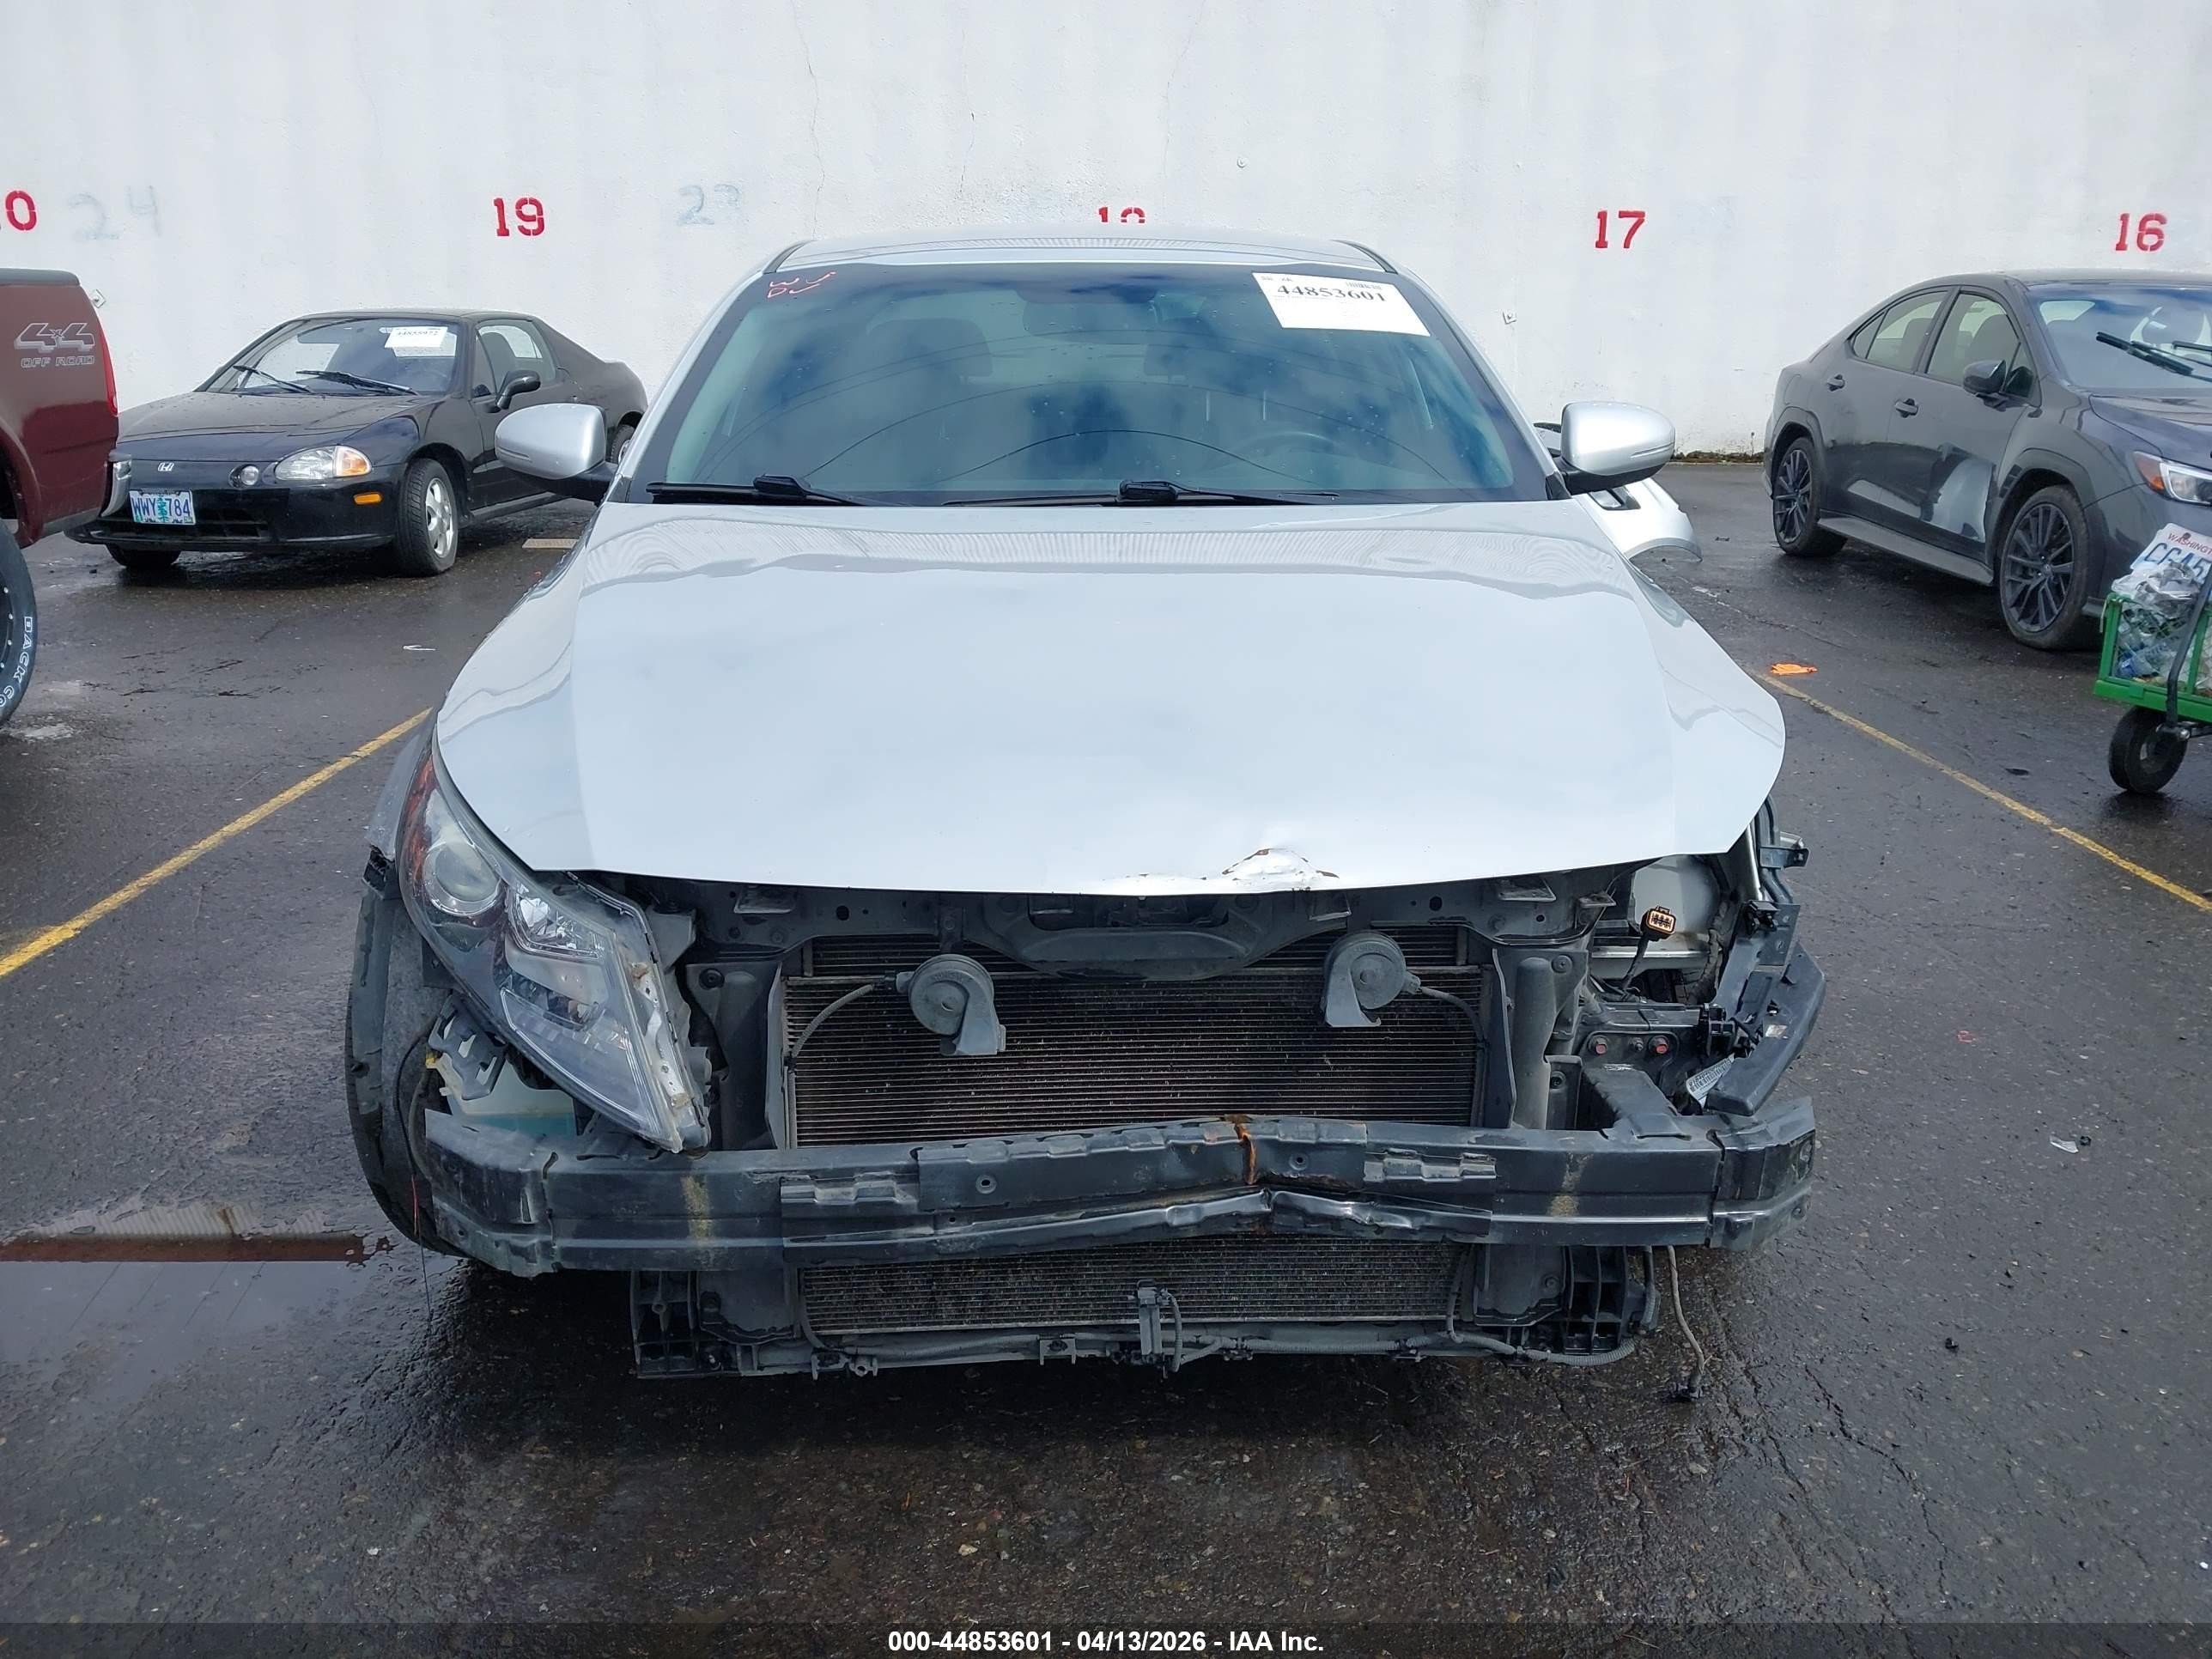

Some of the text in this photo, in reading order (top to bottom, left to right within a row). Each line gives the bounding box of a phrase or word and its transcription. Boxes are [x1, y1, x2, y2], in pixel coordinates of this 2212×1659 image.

[493, 197, 545, 237] 19
[1595, 210, 1646, 249] 17
[2115, 213, 2167, 252] 16
[1277, 284, 1387, 302] 44853601
[21, 356, 95, 368] OFF ROAD
[132, 498, 191, 518] WWY 784
